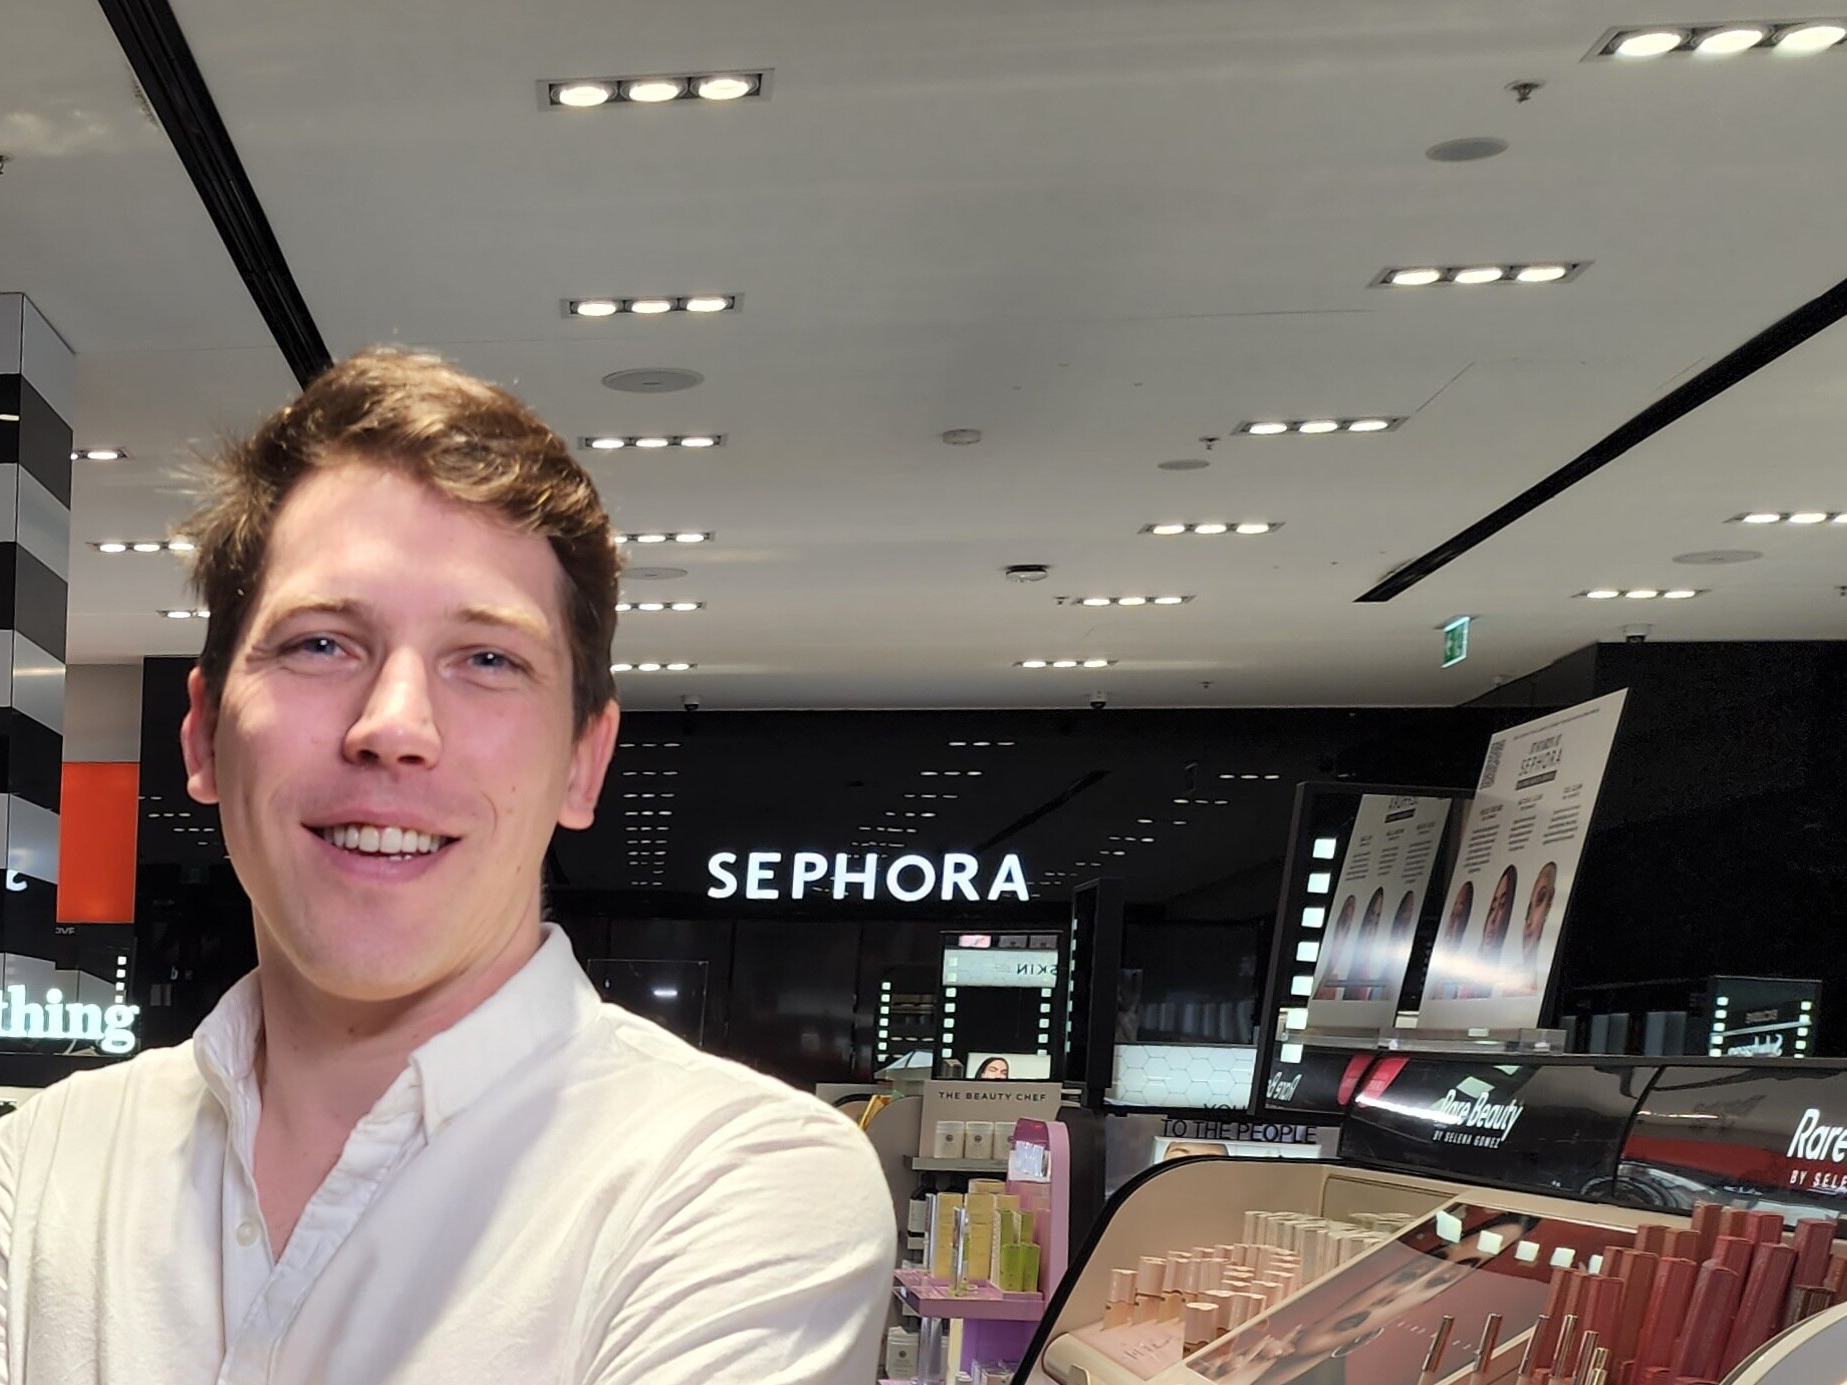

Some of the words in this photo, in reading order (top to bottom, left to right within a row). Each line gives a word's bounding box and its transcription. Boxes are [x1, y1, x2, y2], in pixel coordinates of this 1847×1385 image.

[707, 851, 1031, 902] SEPHORA
[938, 1092, 961, 1101] THE
[965, 1092, 1012, 1102] BEAUTY
[1016, 1093, 1046, 1102] CHEF
[1440, 1089, 1472, 1125] Rare
[1466, 1091, 1524, 1142] Beauty
[1161, 1118, 1187, 1137] TO
[1195, 1121, 1231, 1140] THE
[1236, 1123, 1317, 1144] PEOPLE
[1444, 1131, 1472, 1145] SELENA
[1473, 1135, 1501, 1149] GOMEZ
[1786, 1108, 1847, 1163] Rare
[1789, 1169, 1808, 1185] BY
